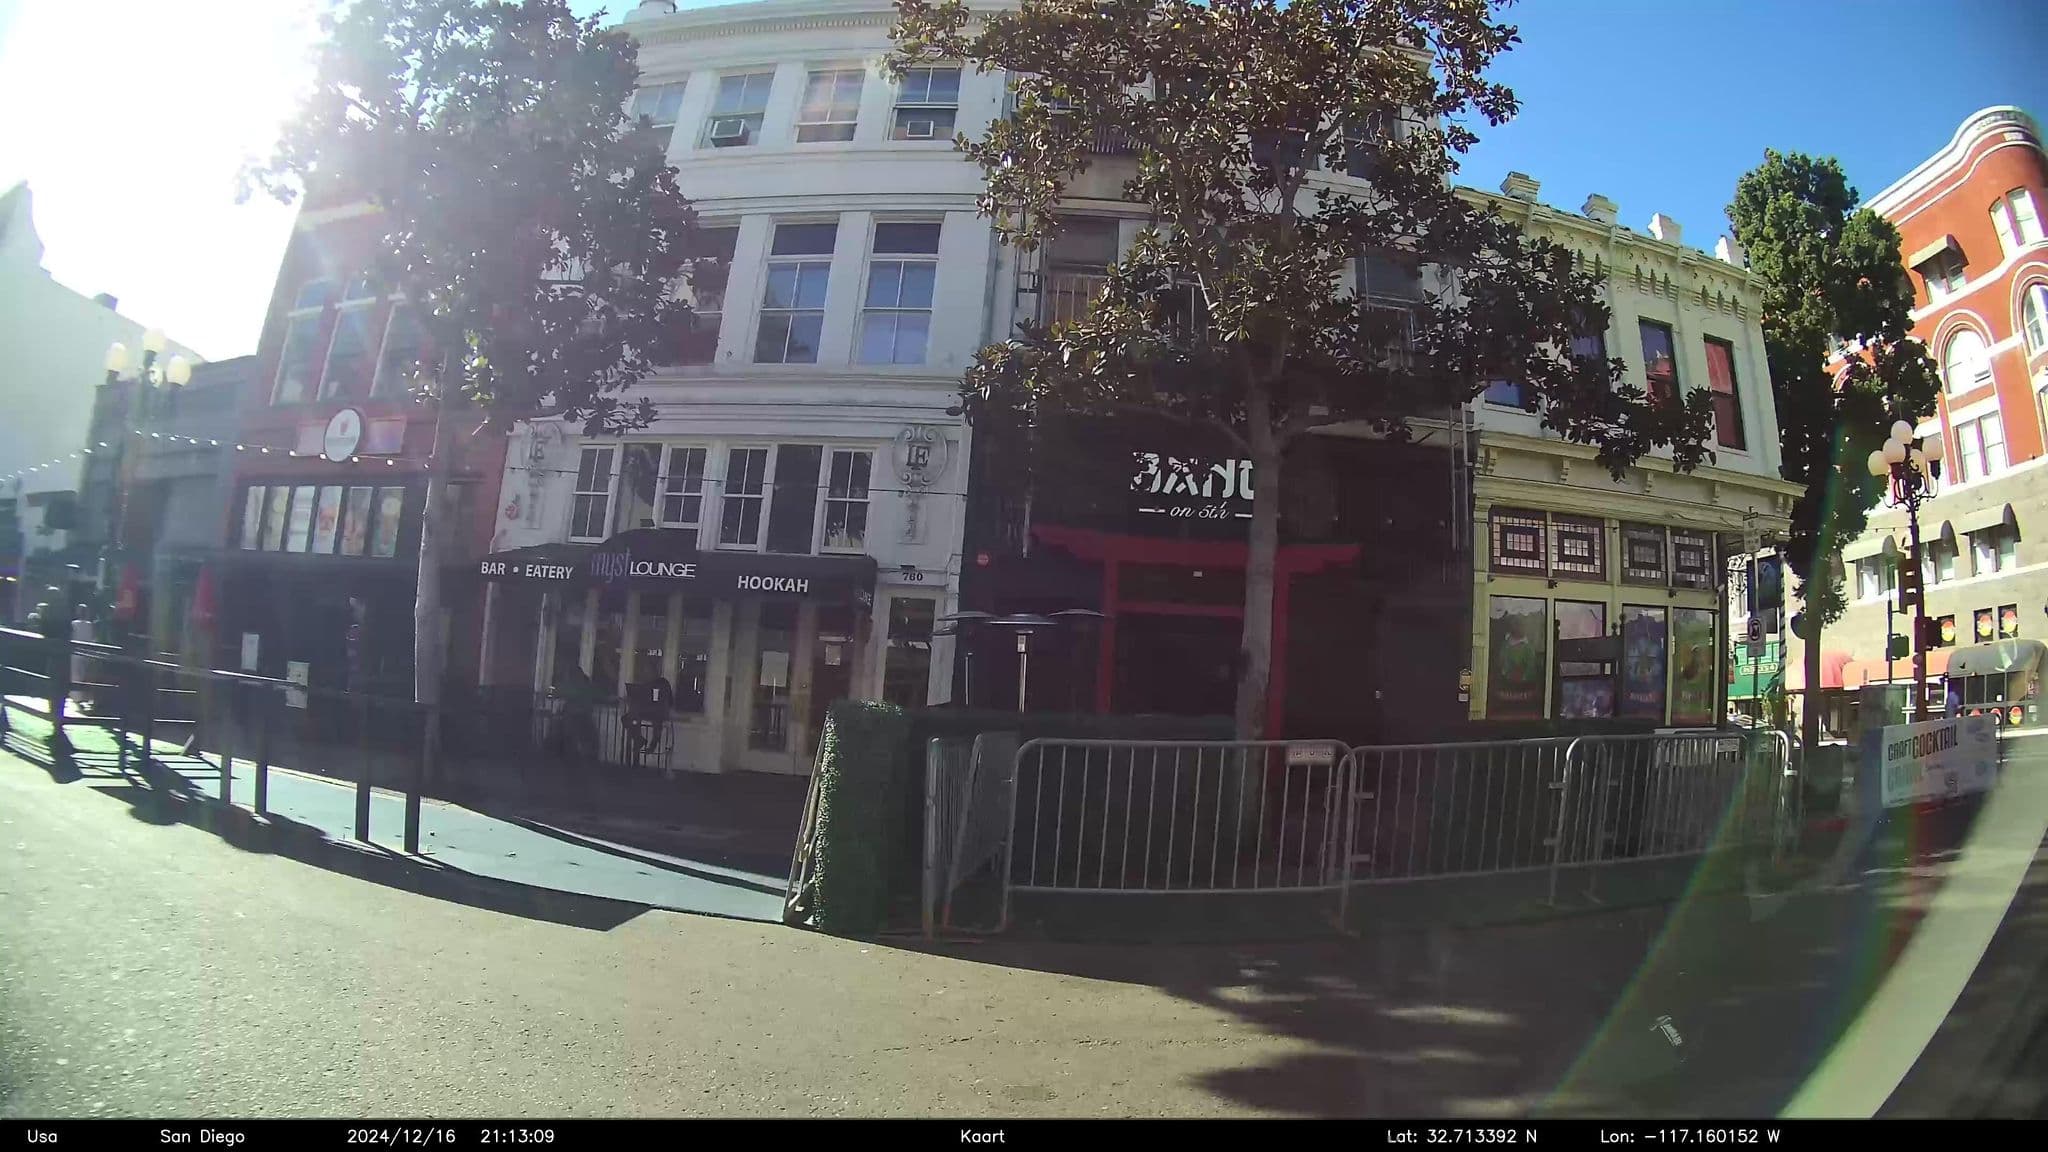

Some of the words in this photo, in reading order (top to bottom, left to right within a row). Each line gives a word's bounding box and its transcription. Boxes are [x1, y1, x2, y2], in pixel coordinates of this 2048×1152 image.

[1169, 505, 1194, 518] on
[1198, 500, 1230, 520] 5th
[480, 561, 506, 576] BAR
[525, 564, 574, 580] EATERY
[629, 561, 697, 578] LOUNGE
[903, 572, 923, 582] 760
[737, 575, 809, 593] HOOKAH
[1887, 739, 1912, 761] CRAFT
[1912, 725, 1958, 760] COCKTAIL
